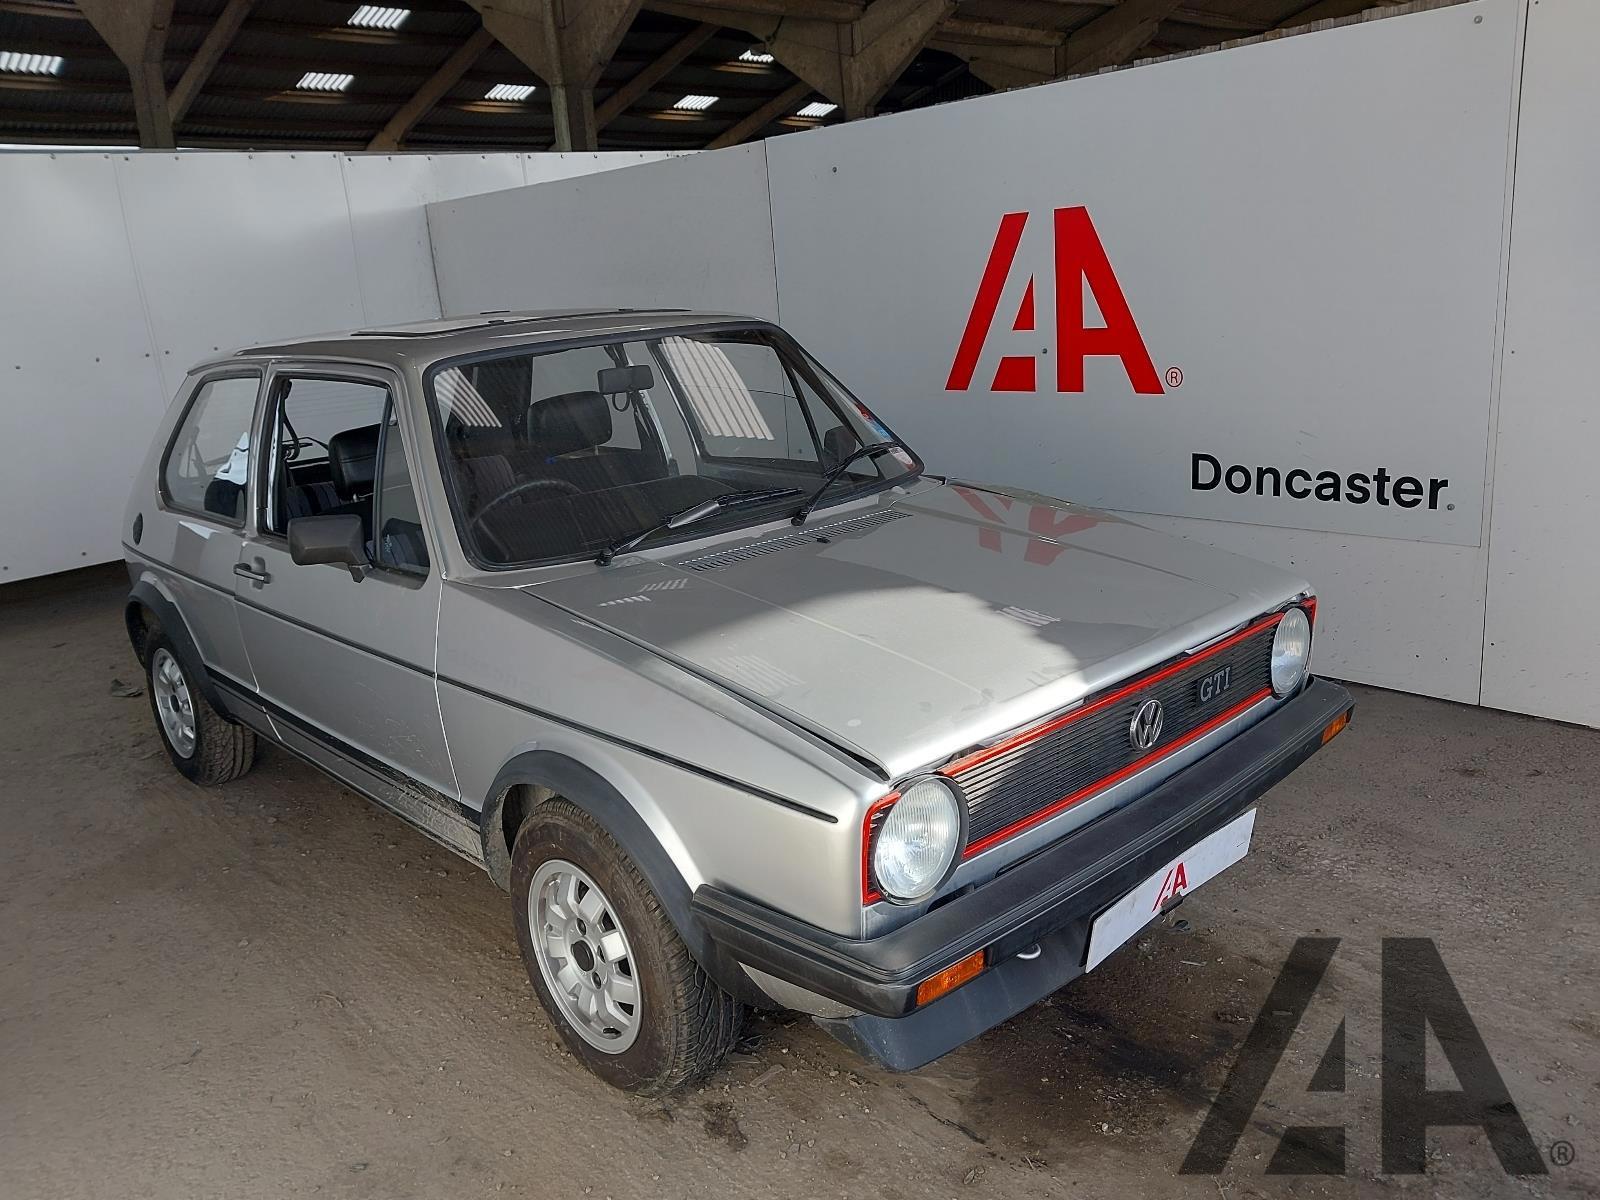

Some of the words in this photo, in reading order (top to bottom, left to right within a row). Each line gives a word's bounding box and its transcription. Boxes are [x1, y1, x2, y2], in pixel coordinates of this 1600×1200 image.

[945, 206, 1165, 394] AA
[1190, 453, 1449, 510] Doncaster
[1200, 667, 1232, 702] GTI
